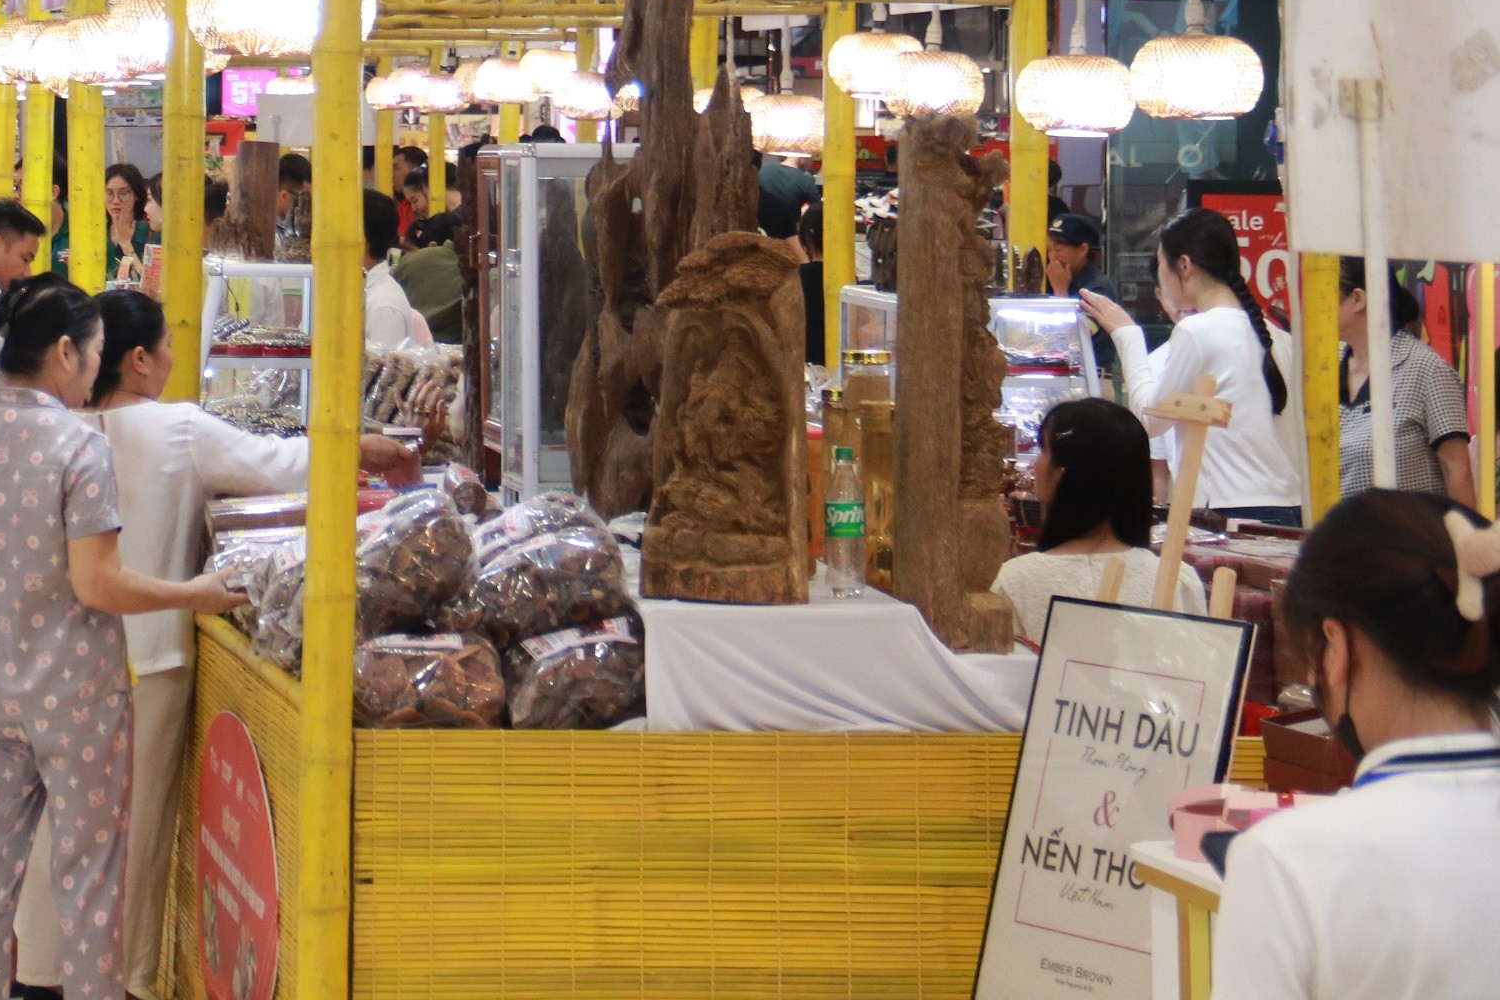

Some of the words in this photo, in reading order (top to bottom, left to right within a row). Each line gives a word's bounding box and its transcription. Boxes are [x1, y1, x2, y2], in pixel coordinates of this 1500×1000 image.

[1227, 209, 1264, 231] ale
[1053, 699, 1125, 745] TINH
[1133, 701, 1200, 758] DẦU
[1093, 790, 1120, 828] &
[1020, 827, 1082, 876] NẾN
